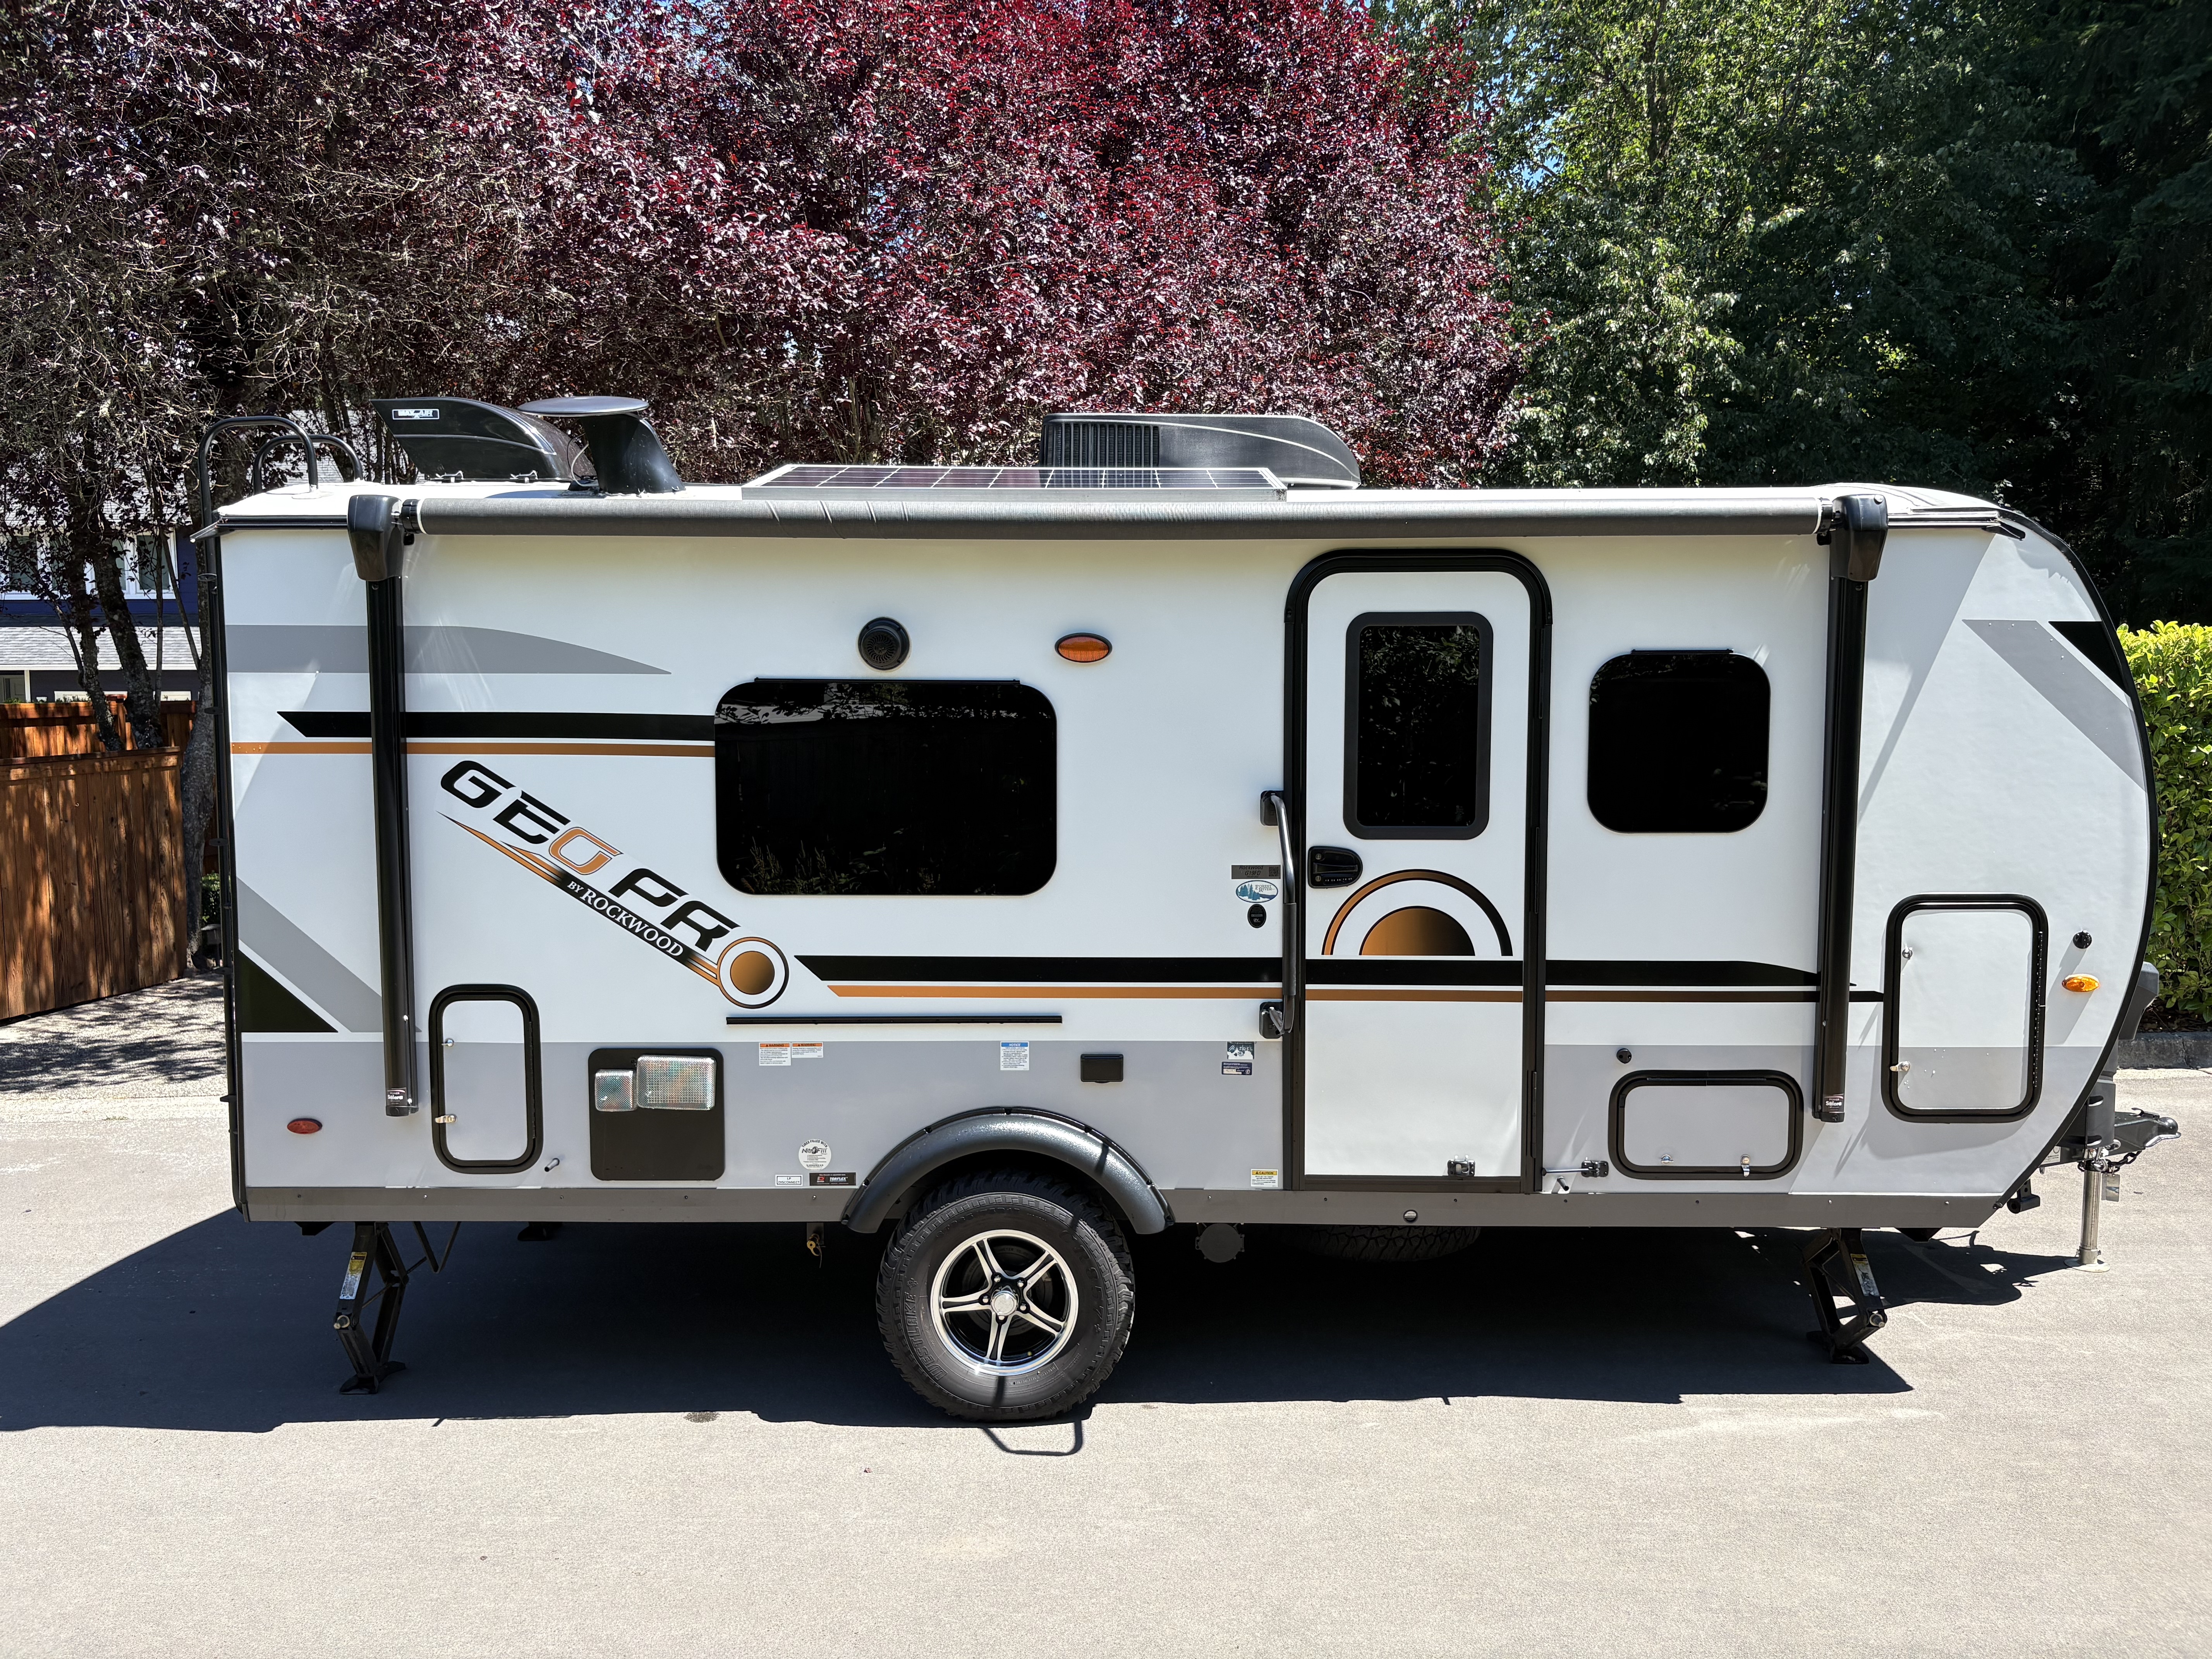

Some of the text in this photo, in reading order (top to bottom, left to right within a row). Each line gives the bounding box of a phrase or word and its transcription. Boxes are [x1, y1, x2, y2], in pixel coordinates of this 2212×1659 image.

[440, 760, 623, 876] GEO
[567, 881, 684, 958] BY ROCKWOOD
[904, 1291, 948, 1381] WESTLAKE
